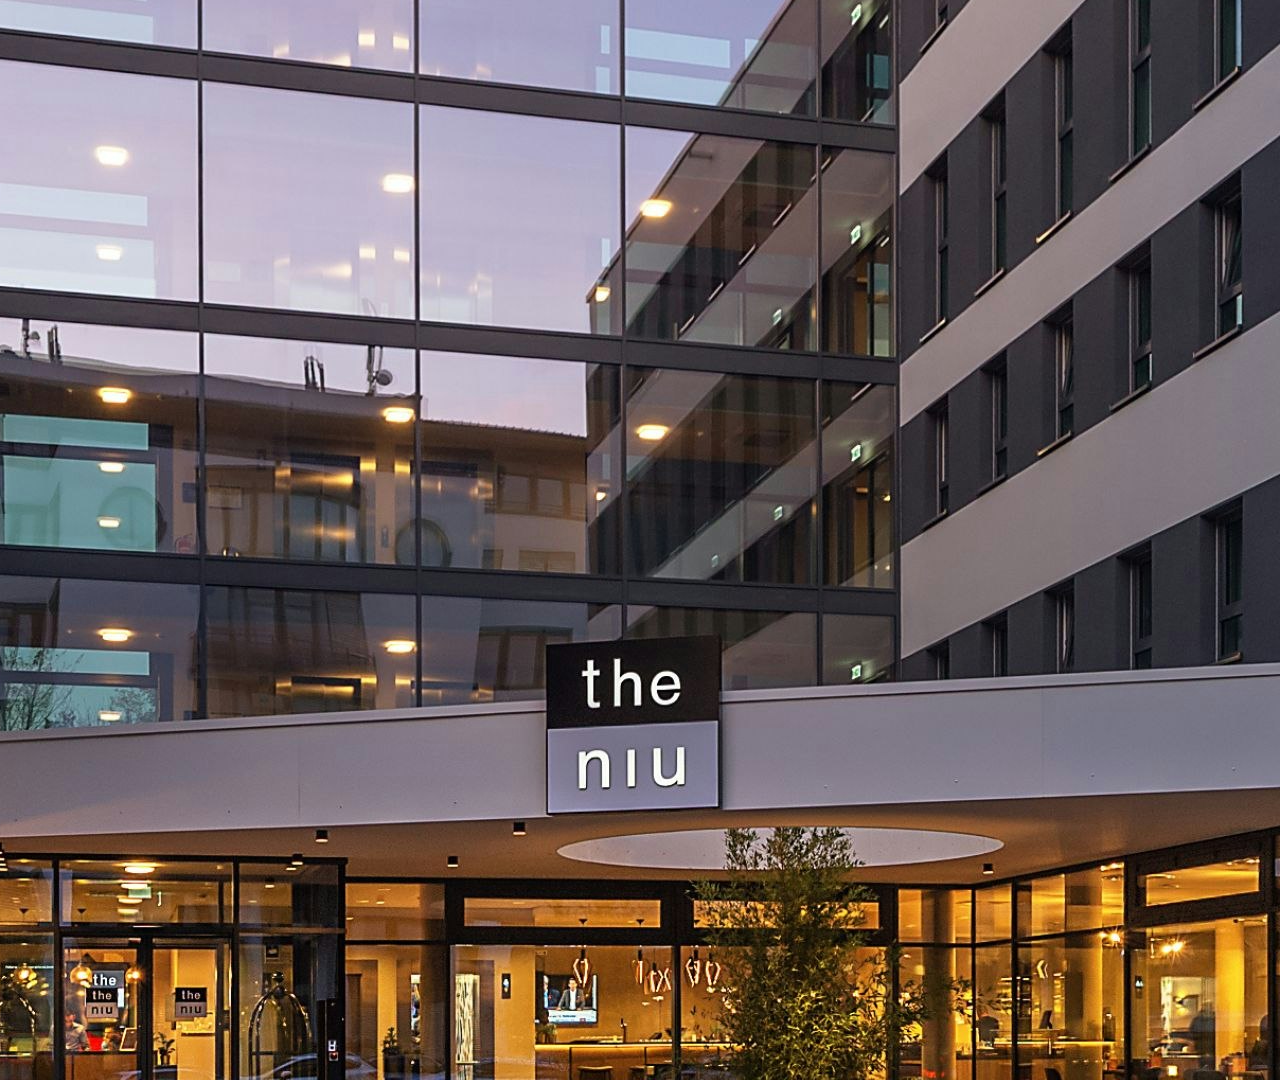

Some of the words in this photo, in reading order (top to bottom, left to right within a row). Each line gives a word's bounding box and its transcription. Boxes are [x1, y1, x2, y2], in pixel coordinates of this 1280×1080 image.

[581, 658, 681, 708] the
[577, 746, 686, 790] niu
[93, 973, 117, 986] the
[92, 990, 112, 1000] the
[181, 990, 200, 1000] the
[91, 1006, 113, 1015] niu
[180, 1005, 201, 1014] niu
